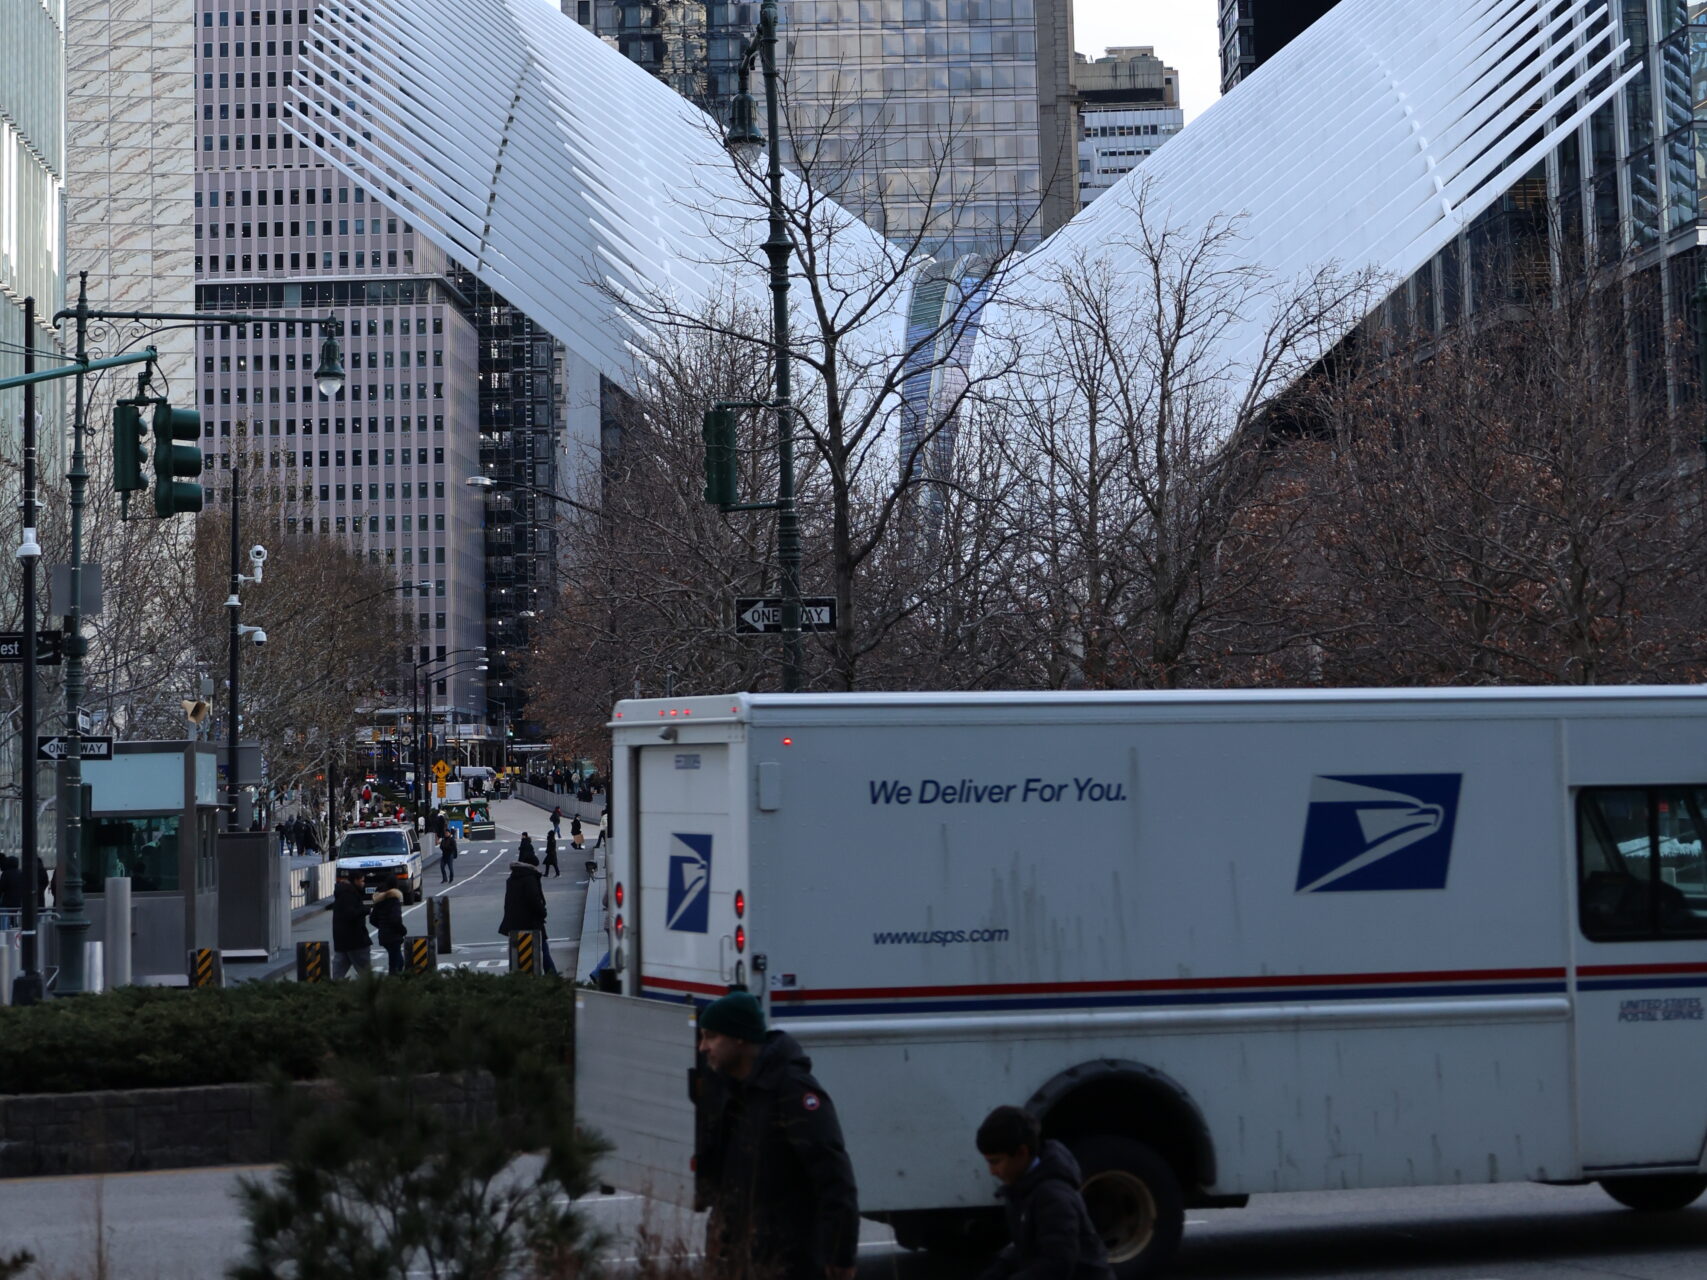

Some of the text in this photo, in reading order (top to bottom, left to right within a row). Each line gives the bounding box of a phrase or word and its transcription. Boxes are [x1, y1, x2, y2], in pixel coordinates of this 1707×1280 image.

[751, 608, 824, 623] ONE AY
[49, 743, 103, 754] ONE WAY
[869, 777, 1127, 805] We Deliver For You.
[873, 928, 1009, 947] www.usps.com
